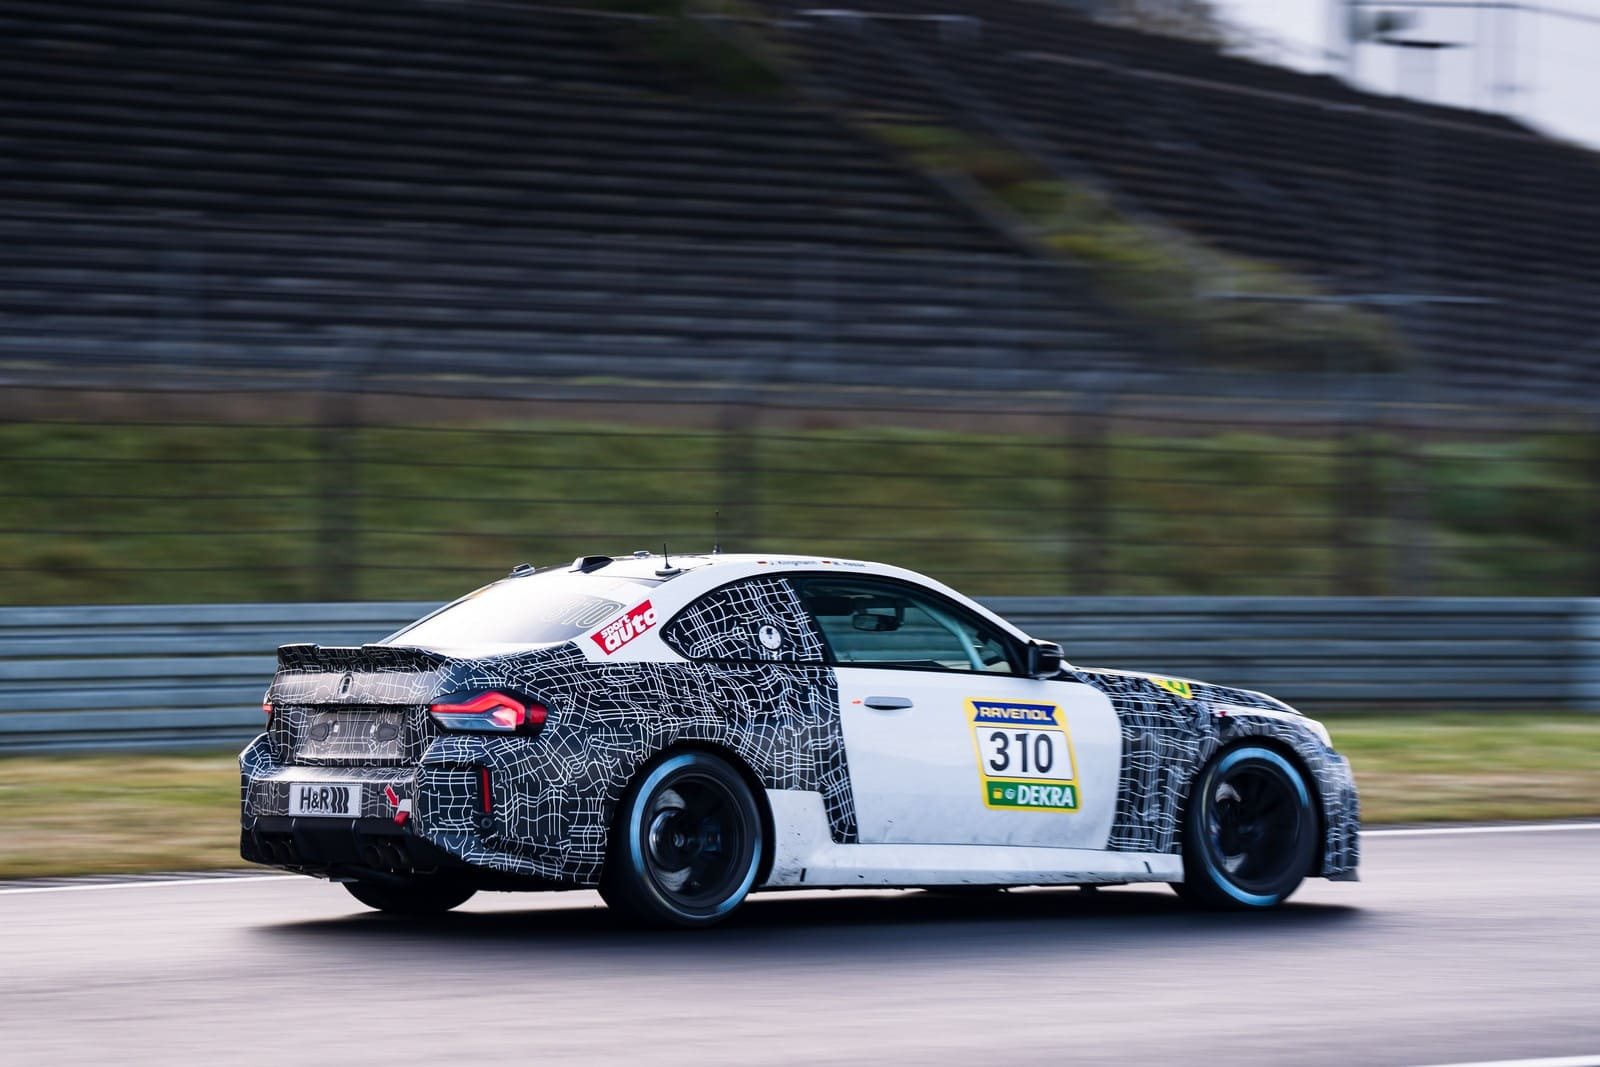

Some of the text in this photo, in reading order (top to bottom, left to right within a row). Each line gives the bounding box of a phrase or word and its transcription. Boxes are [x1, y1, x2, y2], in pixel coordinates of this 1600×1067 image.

[600, 614, 631, 639] sport
[604, 607, 657, 652] auto
[978, 706, 1053, 721] RAVENOL
[989, 731, 1054, 774] 310
[300, 786, 329, 811] H&R
[1016, 784, 1075, 808] DEKRA
